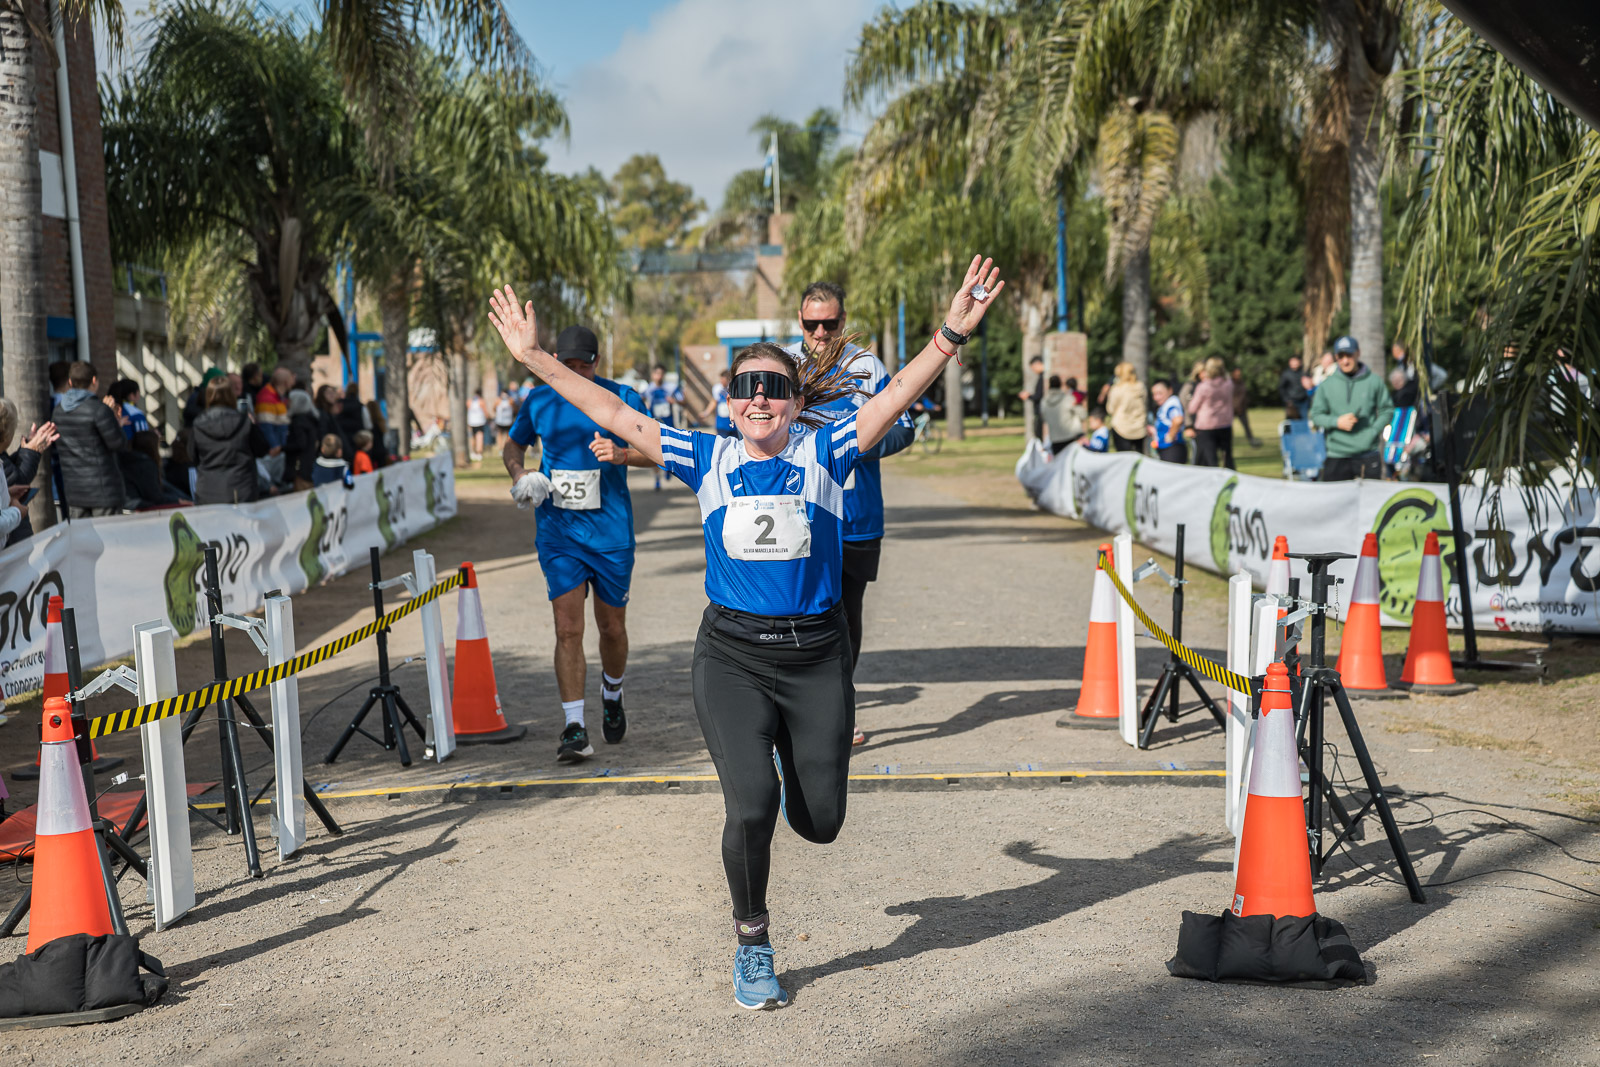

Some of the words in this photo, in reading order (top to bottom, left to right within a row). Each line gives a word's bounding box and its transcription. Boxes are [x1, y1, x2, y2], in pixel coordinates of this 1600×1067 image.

[561, 481, 586, 499] 25
[754, 499, 760, 510] 3
[754, 514, 777, 545] 2
